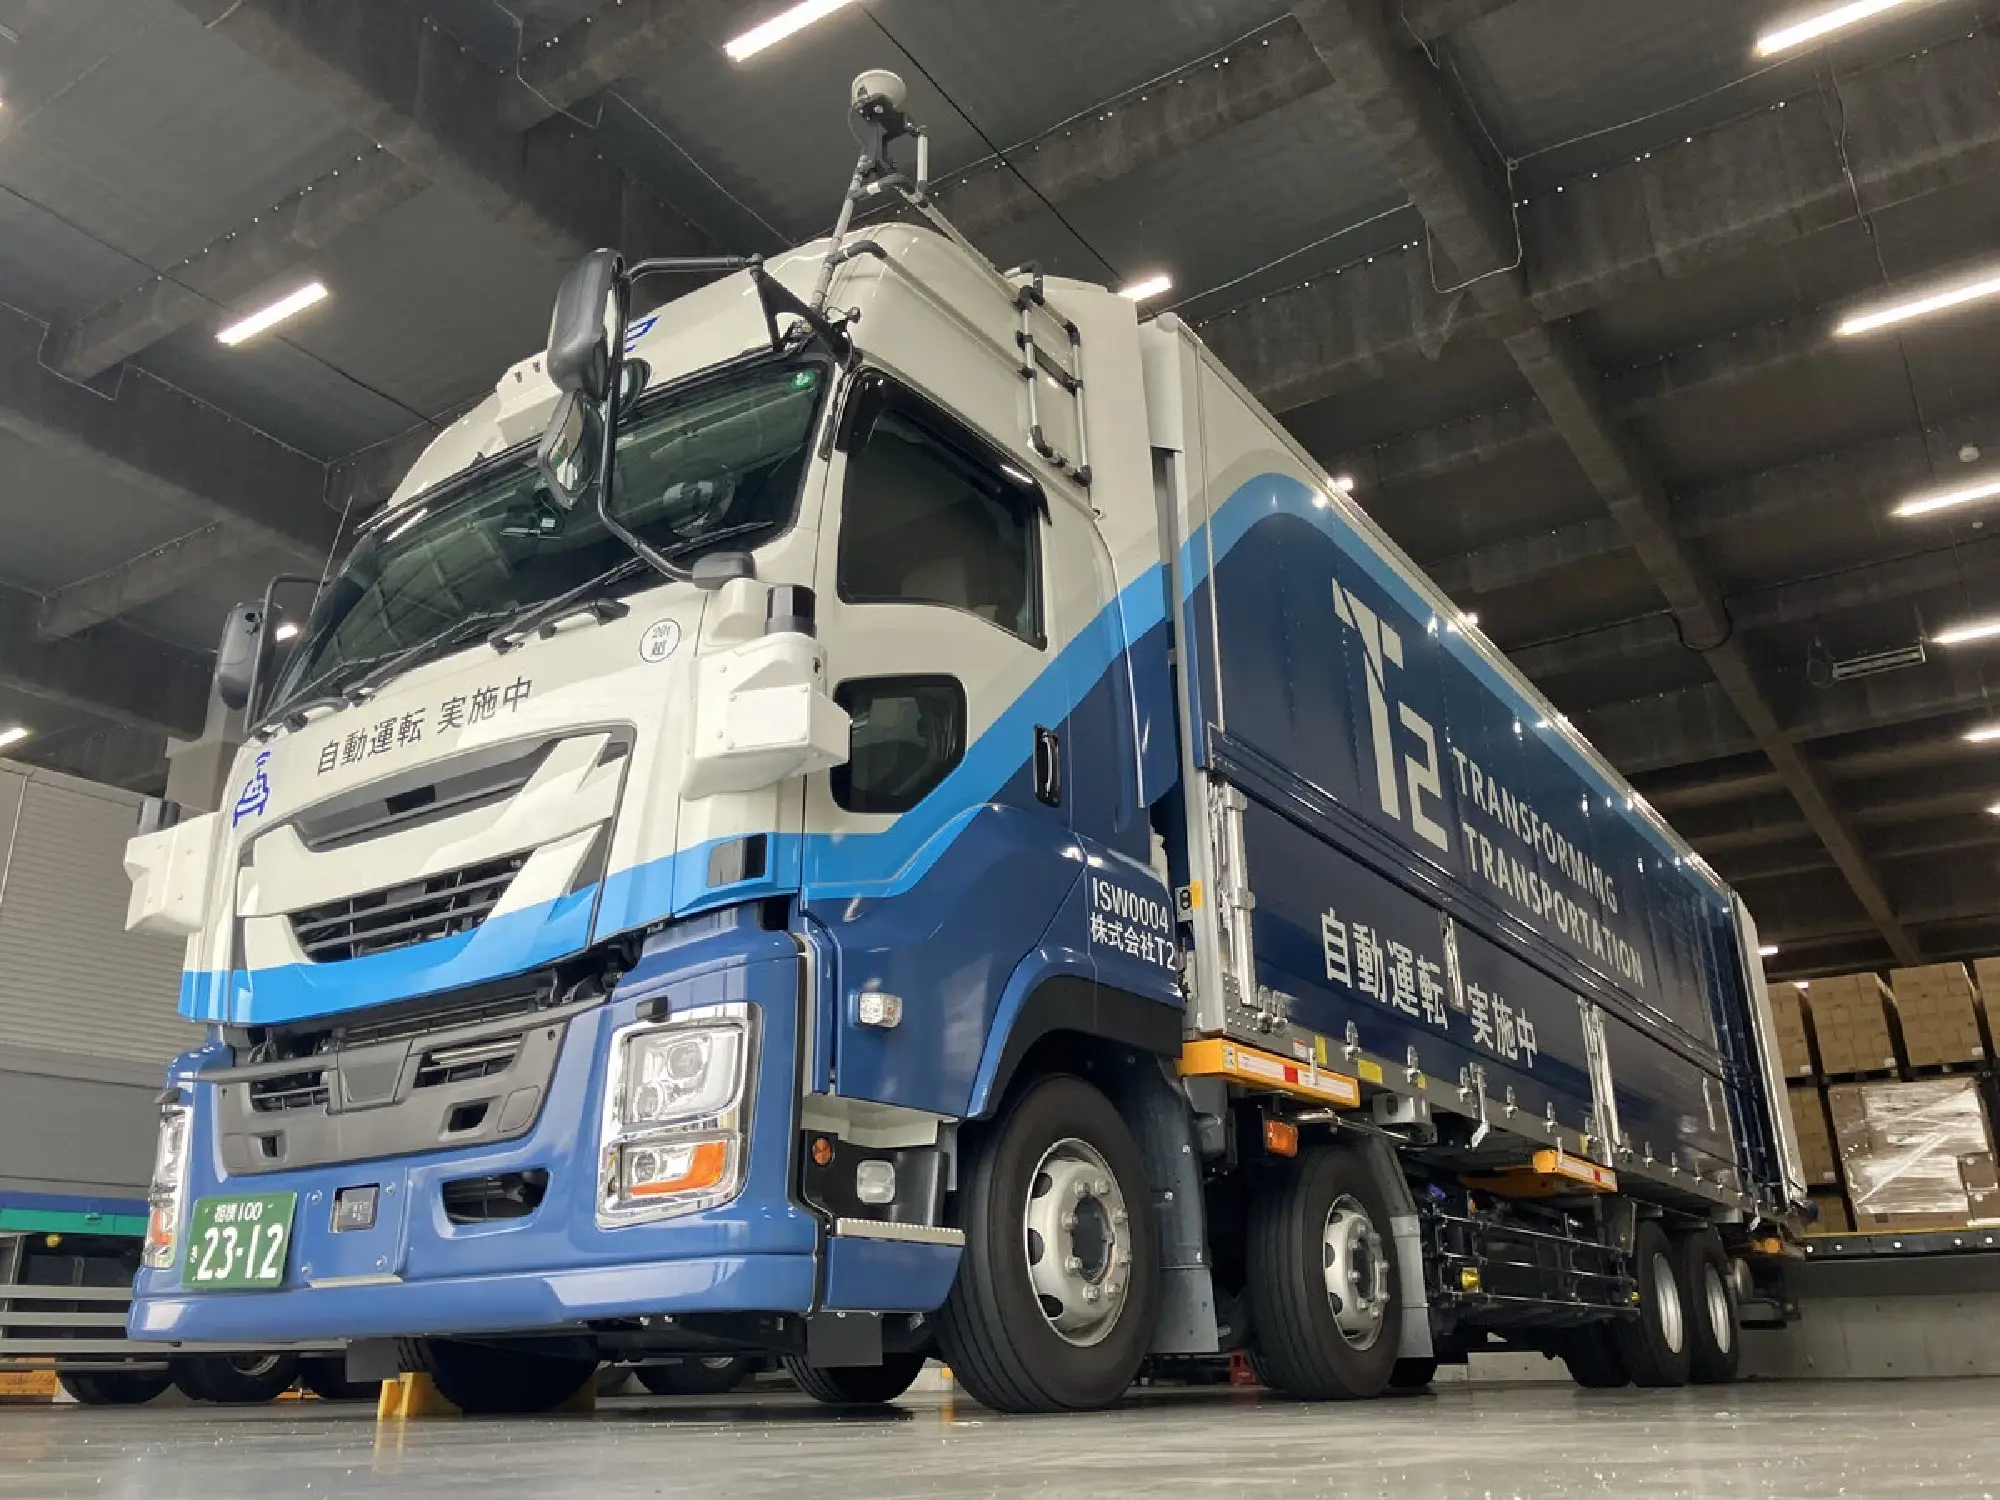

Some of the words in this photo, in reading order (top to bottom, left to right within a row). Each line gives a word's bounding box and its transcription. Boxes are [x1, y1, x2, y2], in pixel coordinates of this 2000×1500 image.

[318, 707, 426, 776] 自動運転
[437, 675, 533, 735] 実施中
[1332, 577, 1449, 853] T2
[1092, 877, 1169, 933] ISW0004
[1453, 746, 1619, 914] TRANSFORMING
[1462, 821, 1644, 988] TRANSPORTATION
[1090, 911, 1176, 971] 株式会社T2
[1321, 906, 1448, 1031] 自動運転
[1467, 982, 1538, 1069] 実施中
